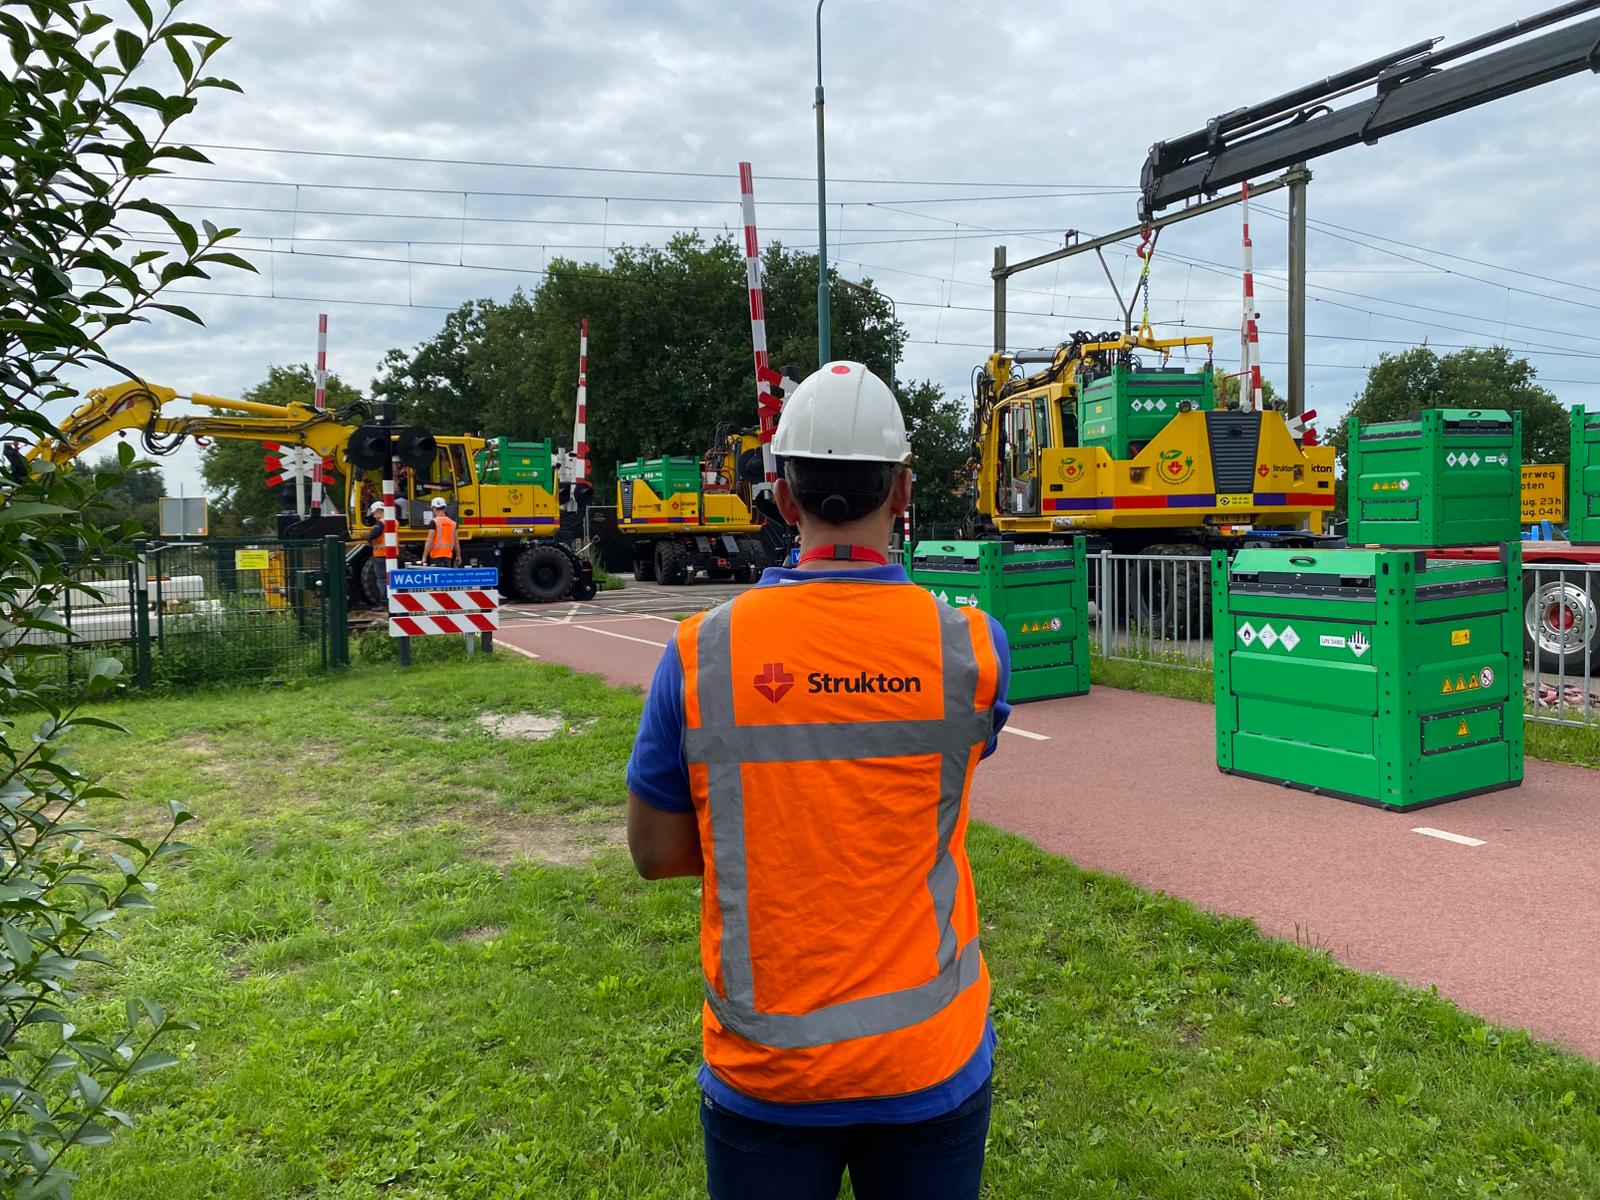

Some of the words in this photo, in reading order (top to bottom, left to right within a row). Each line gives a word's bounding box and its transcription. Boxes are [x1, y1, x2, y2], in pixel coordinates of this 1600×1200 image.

[1311, 464, 1332, 473] kton
[1522, 472, 1555, 480] erweg
[1520, 482, 1545, 490] oten
[1522, 499, 1537, 508] ug.
[1522, 509, 1537, 518] ug.
[394, 574, 439, 585] WACHT
[807, 672, 921, 693] Strukton
